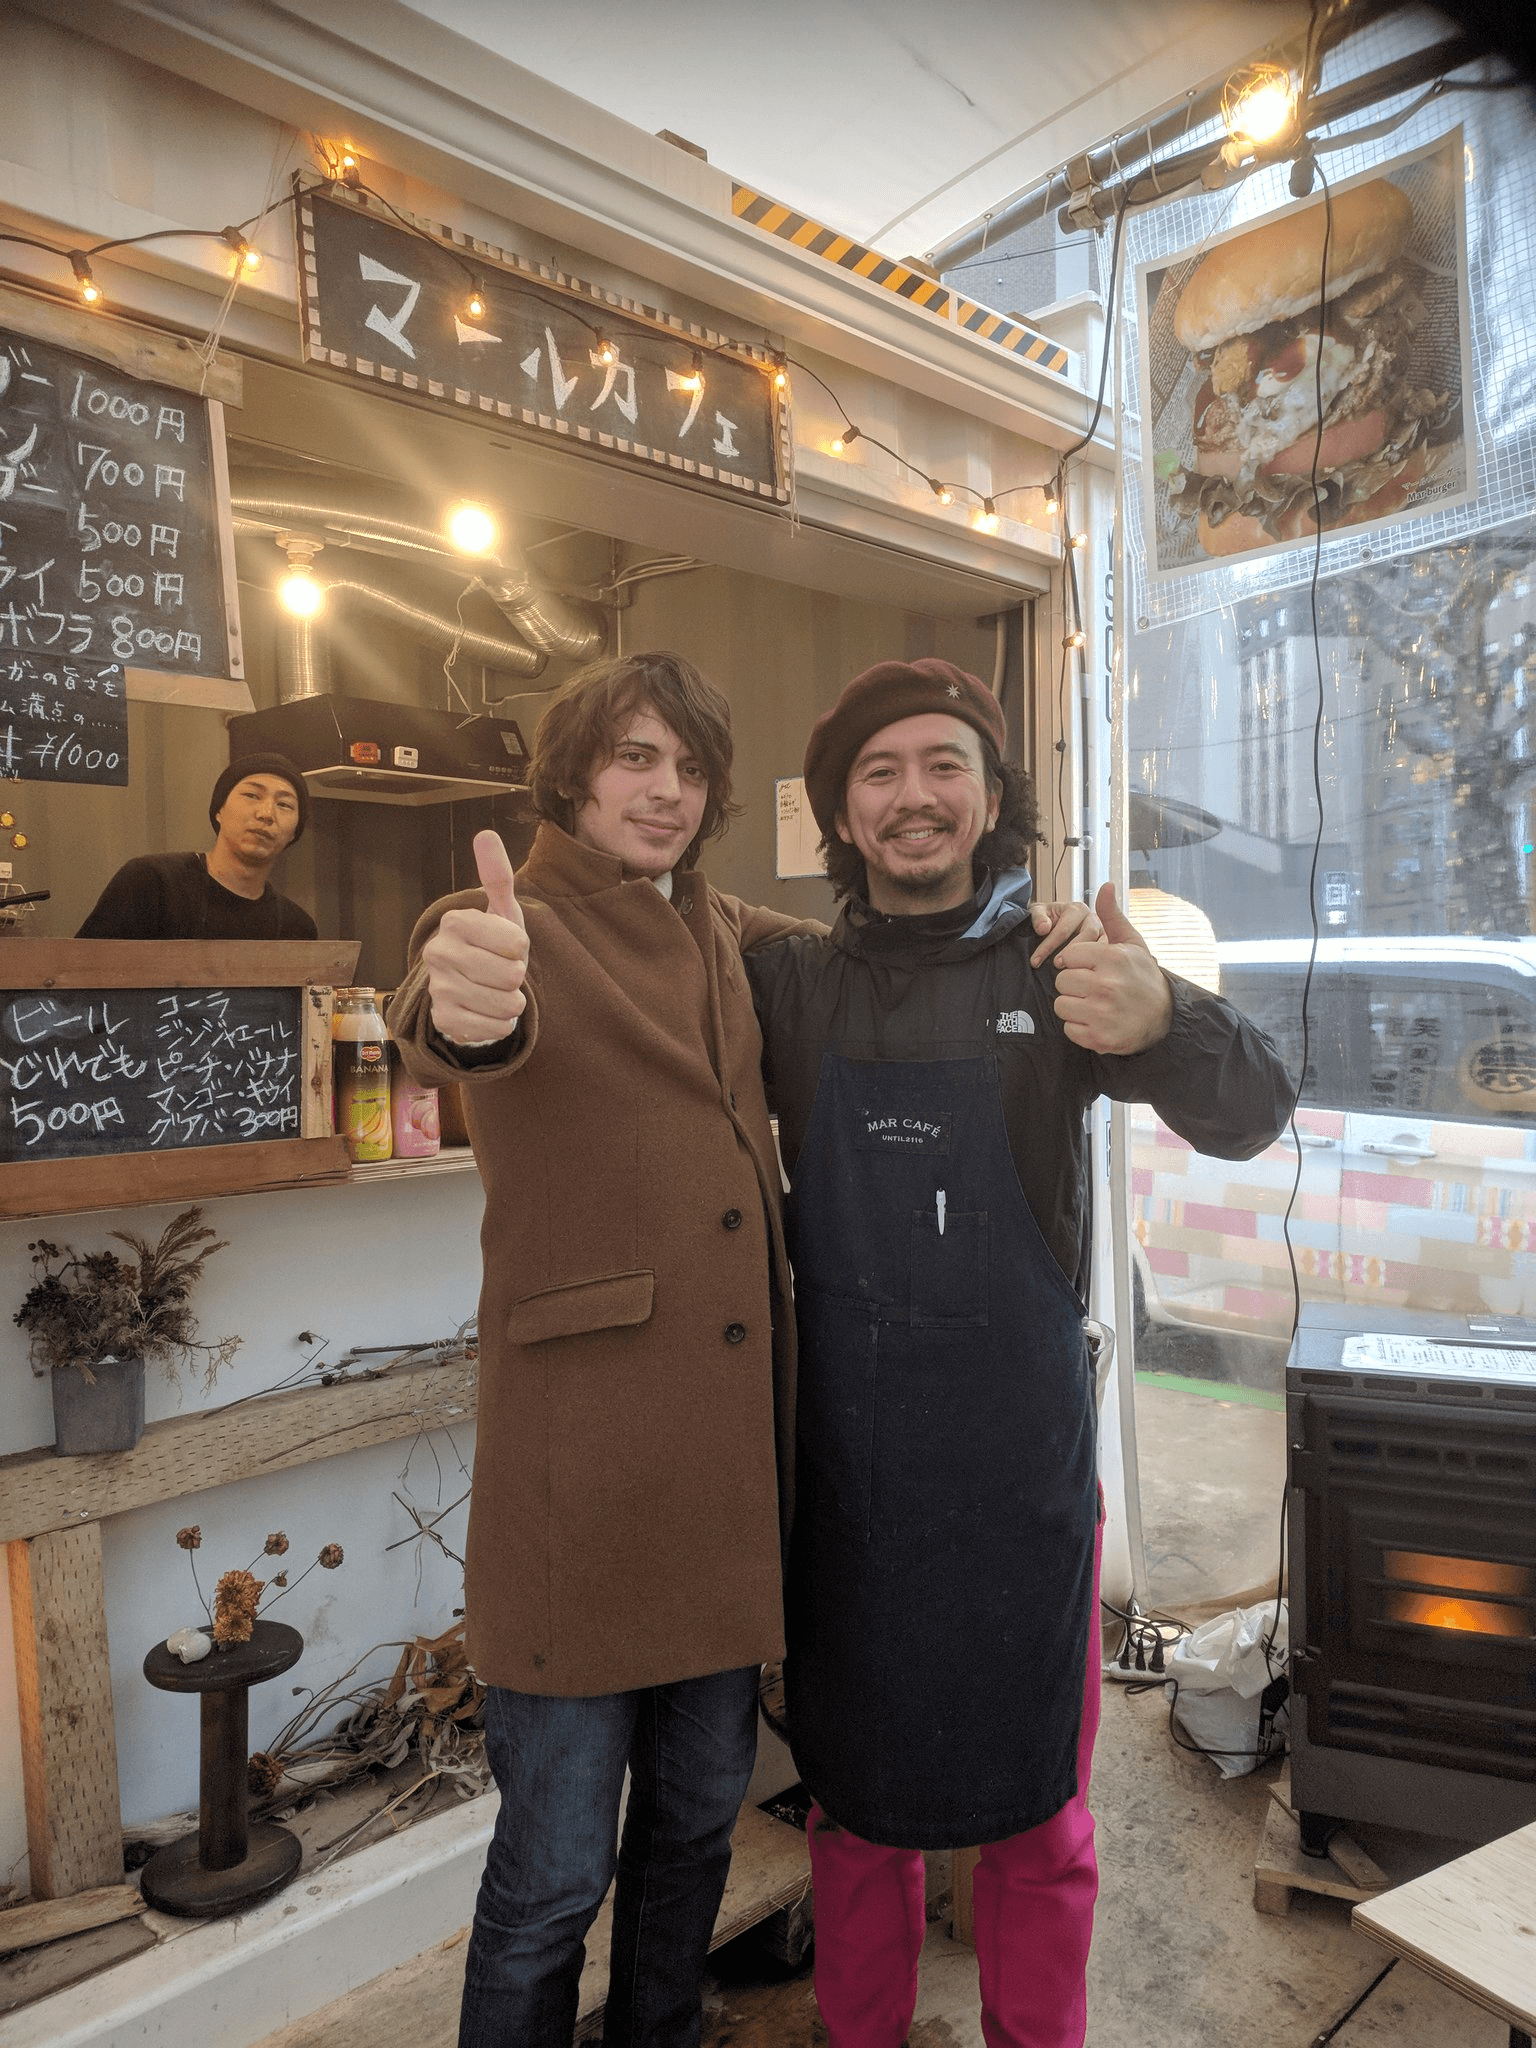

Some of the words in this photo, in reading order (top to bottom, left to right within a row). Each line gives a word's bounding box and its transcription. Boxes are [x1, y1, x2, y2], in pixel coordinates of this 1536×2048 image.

[359, 252, 740, 457] マールカフェ
[71, 374, 185, 443] 1000円
[78, 442, 186, 501] 700円
[1407, 490, 1426, 503] Mar
[1427, 481, 1456, 497] burger
[78, 502, 182, 558] 500円
[78, 560, 184, 606] 500円
[110, 613, 200, 661] 800円
[13, 1000, 130, 1043] ビール
[157, 991, 230, 1019] コーラ
[1000, 1011, 1018, 1020] THE
[0, 1038, 148, 1089] どれでも
[350, 1064, 389, 1074] BANANA
[10, 1096, 125, 1145] 500円
[148, 1107, 228, 1146] グアバ
[232, 1105, 298, 1137] 300円
[867, 1118, 898, 1133] MAR
[902, 1118, 942, 1138] CAFÉ
